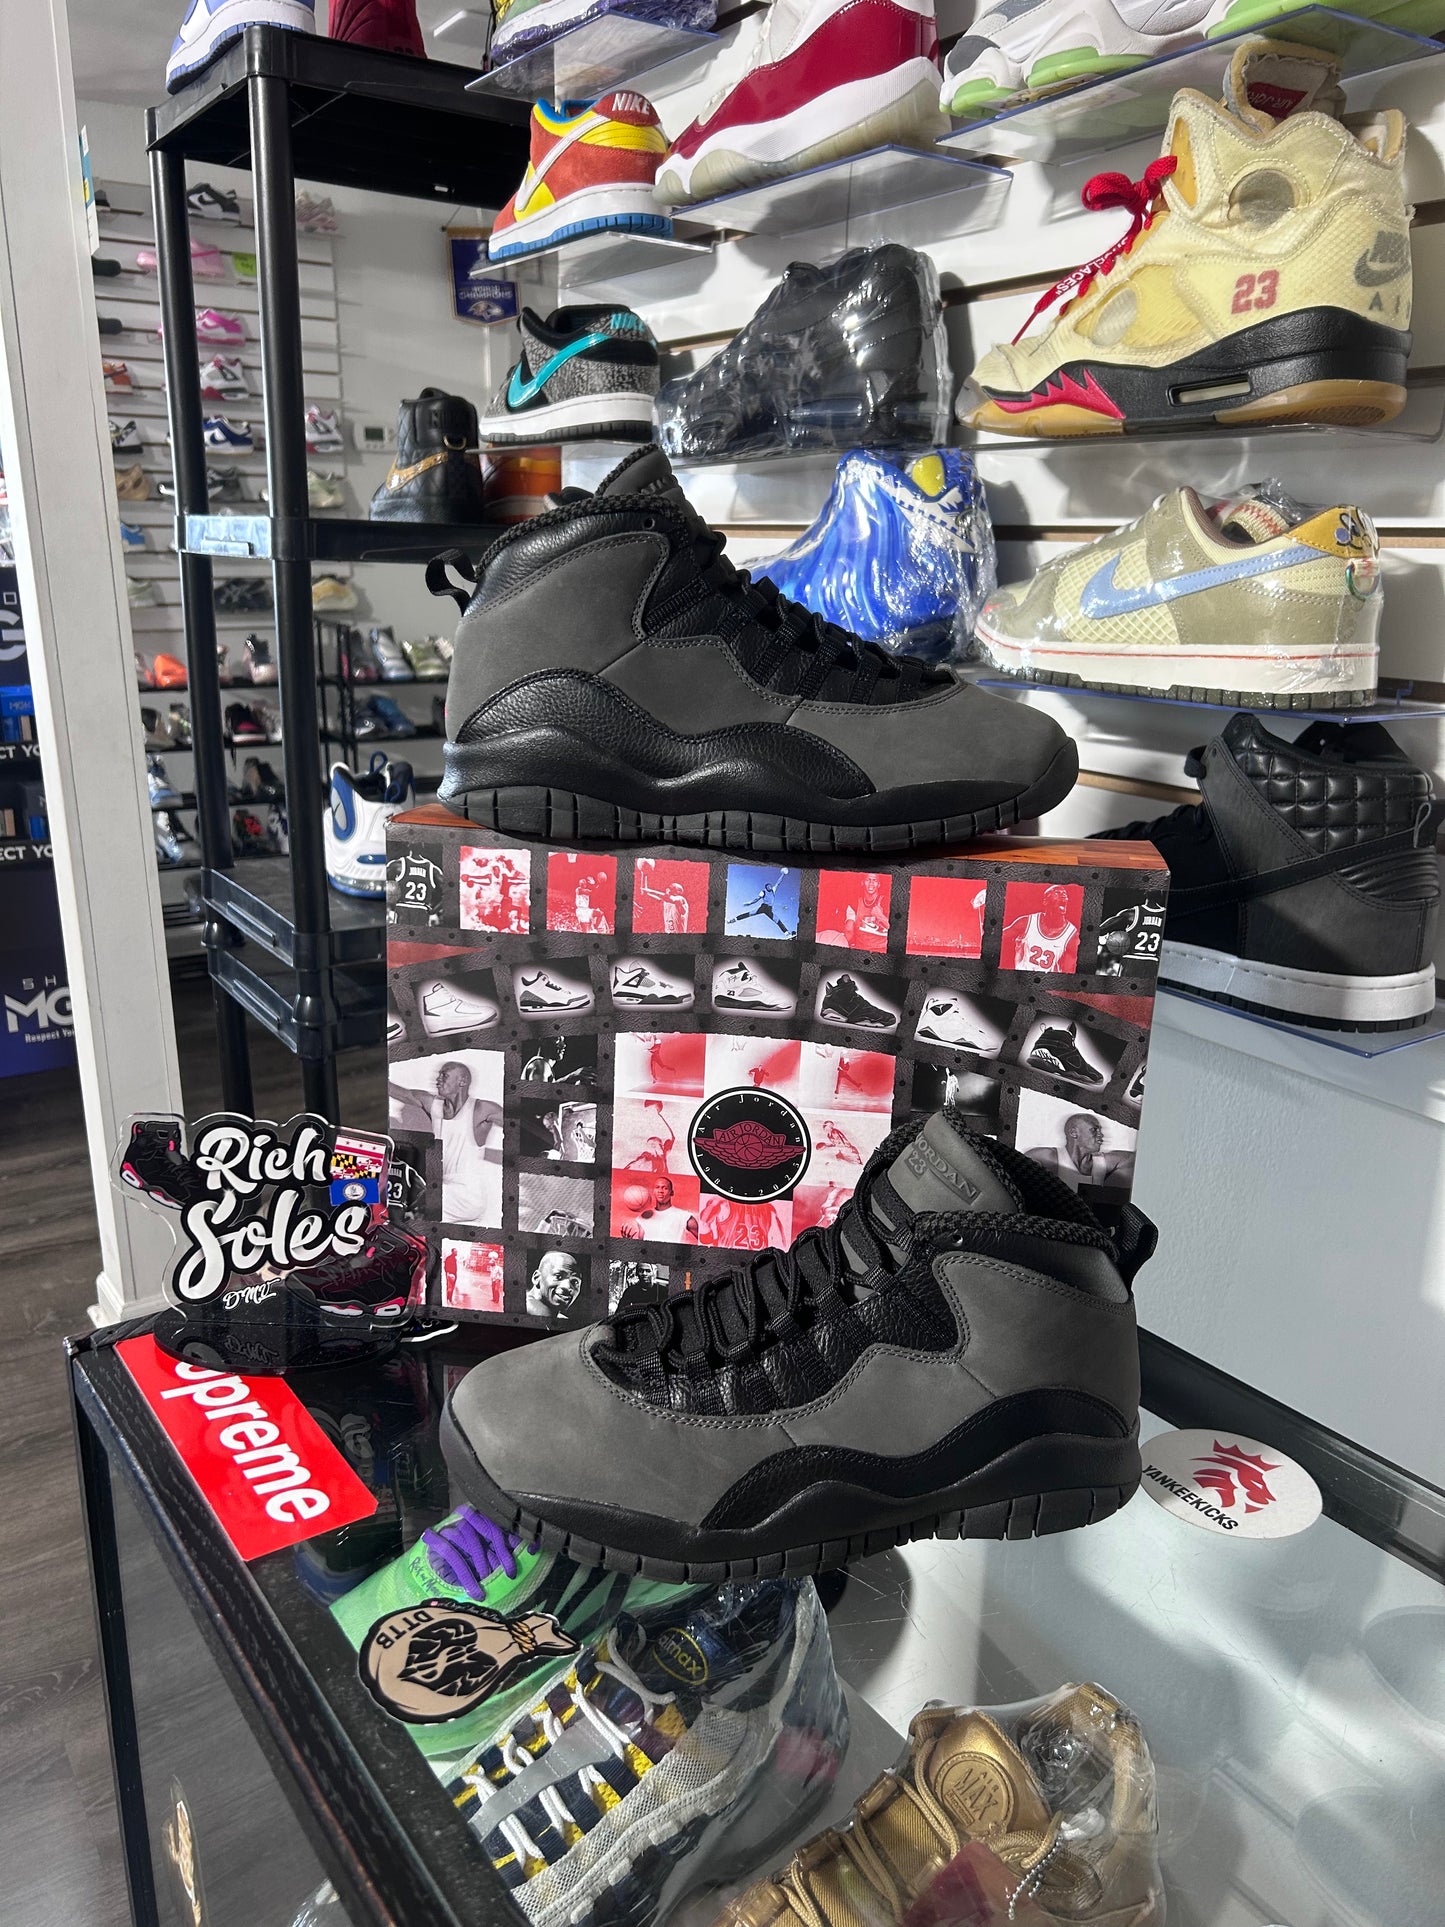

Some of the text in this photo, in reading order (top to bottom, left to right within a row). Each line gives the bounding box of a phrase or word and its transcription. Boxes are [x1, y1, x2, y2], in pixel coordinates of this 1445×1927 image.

[612, 93, 650, 116] NIKE
[1231, 268, 1281, 315] 23
[405, 881, 427, 901] 23
[1029, 945, 1056, 970] 23
[1134, 931, 1161, 952] 23
[25, 1030, 60, 1044] Respect
[719, 1122, 781, 1146] AIR JORDAN
[739, 1094, 801, 1143] Jordan
[196, 1127, 327, 1194] Rich
[908, 1149, 927, 1175] 23
[179, 1189, 366, 1300] Soles
[733, 1222, 765, 1251] 23
[222, 1277, 282, 1310] DMV
[160, 1361, 330, 1522] upreme
[1142, 1464, 1239, 1530] YANKEEKICKS
[376, 1609, 435, 1649] DTTB
[953, 1767, 998, 1820] MAX
